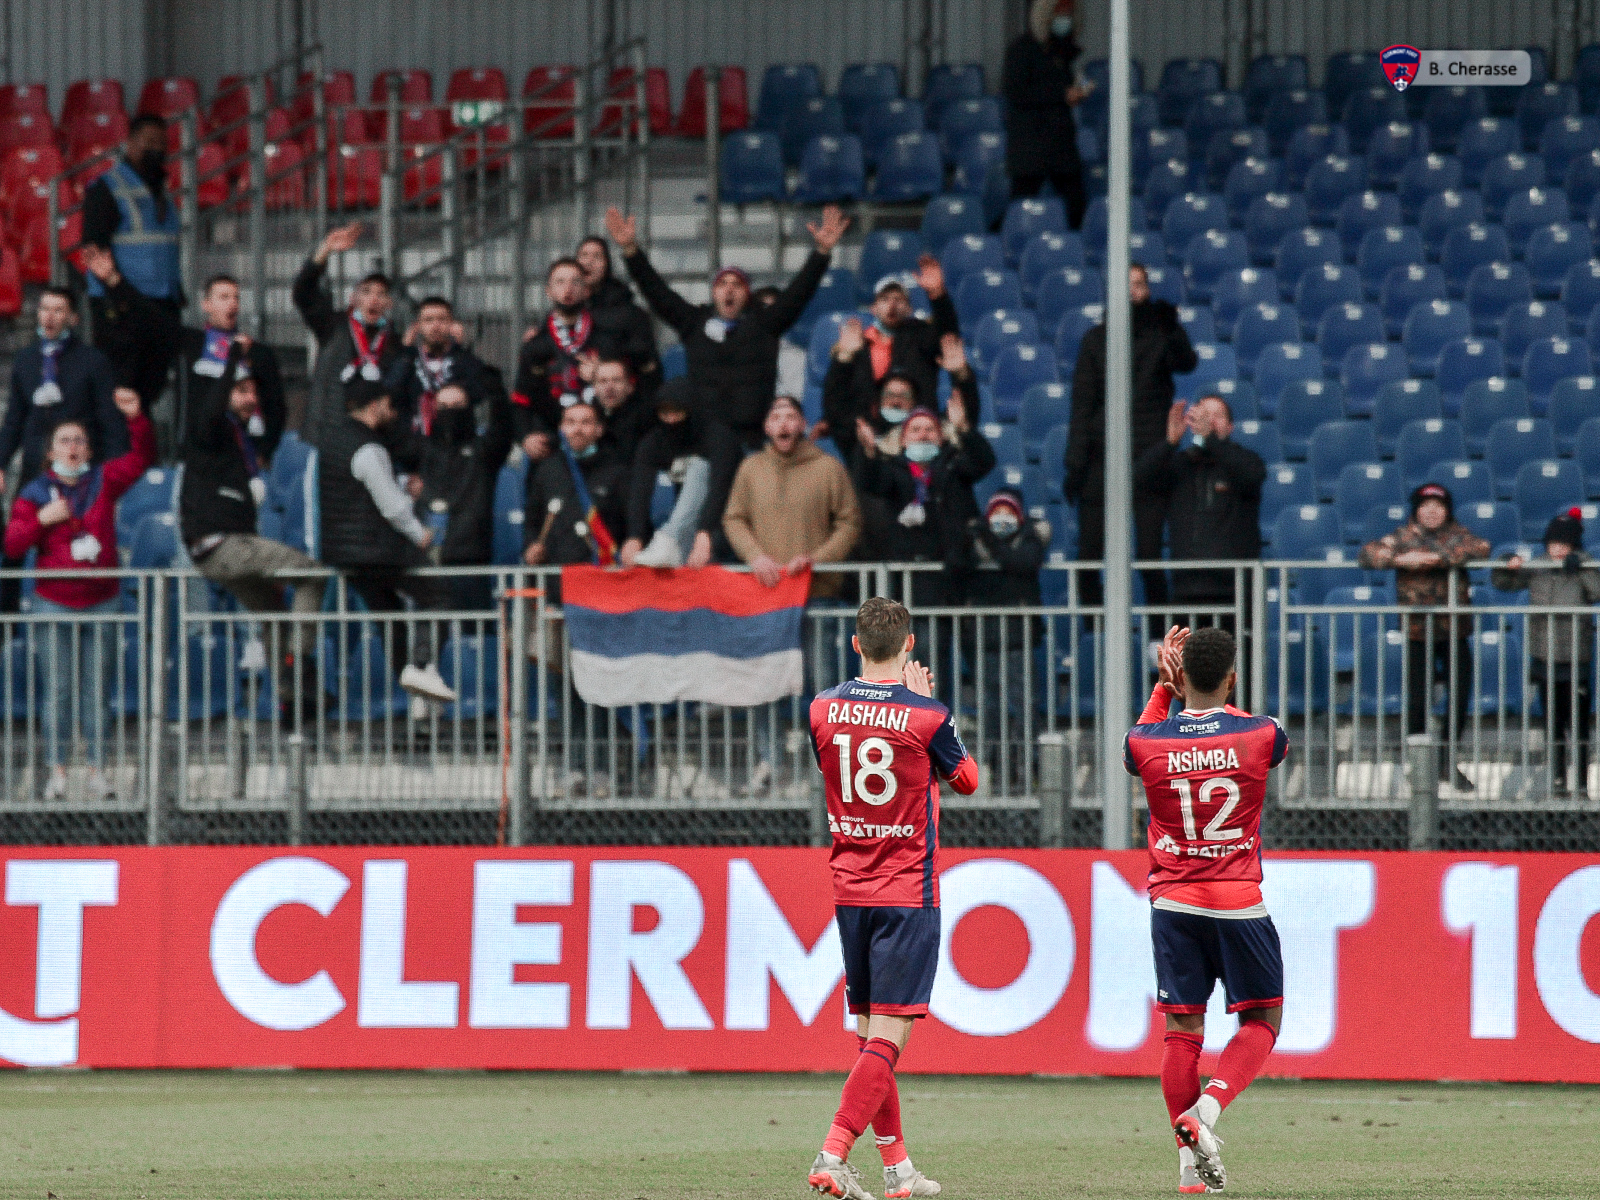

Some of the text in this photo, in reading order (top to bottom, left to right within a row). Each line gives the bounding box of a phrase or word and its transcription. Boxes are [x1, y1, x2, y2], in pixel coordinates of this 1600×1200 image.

[832, 733, 898, 806] 18
[840, 815, 865, 823] GROUPE
[1170, 777, 1243, 841] 12
[840, 822, 914, 838] BATIPRO
